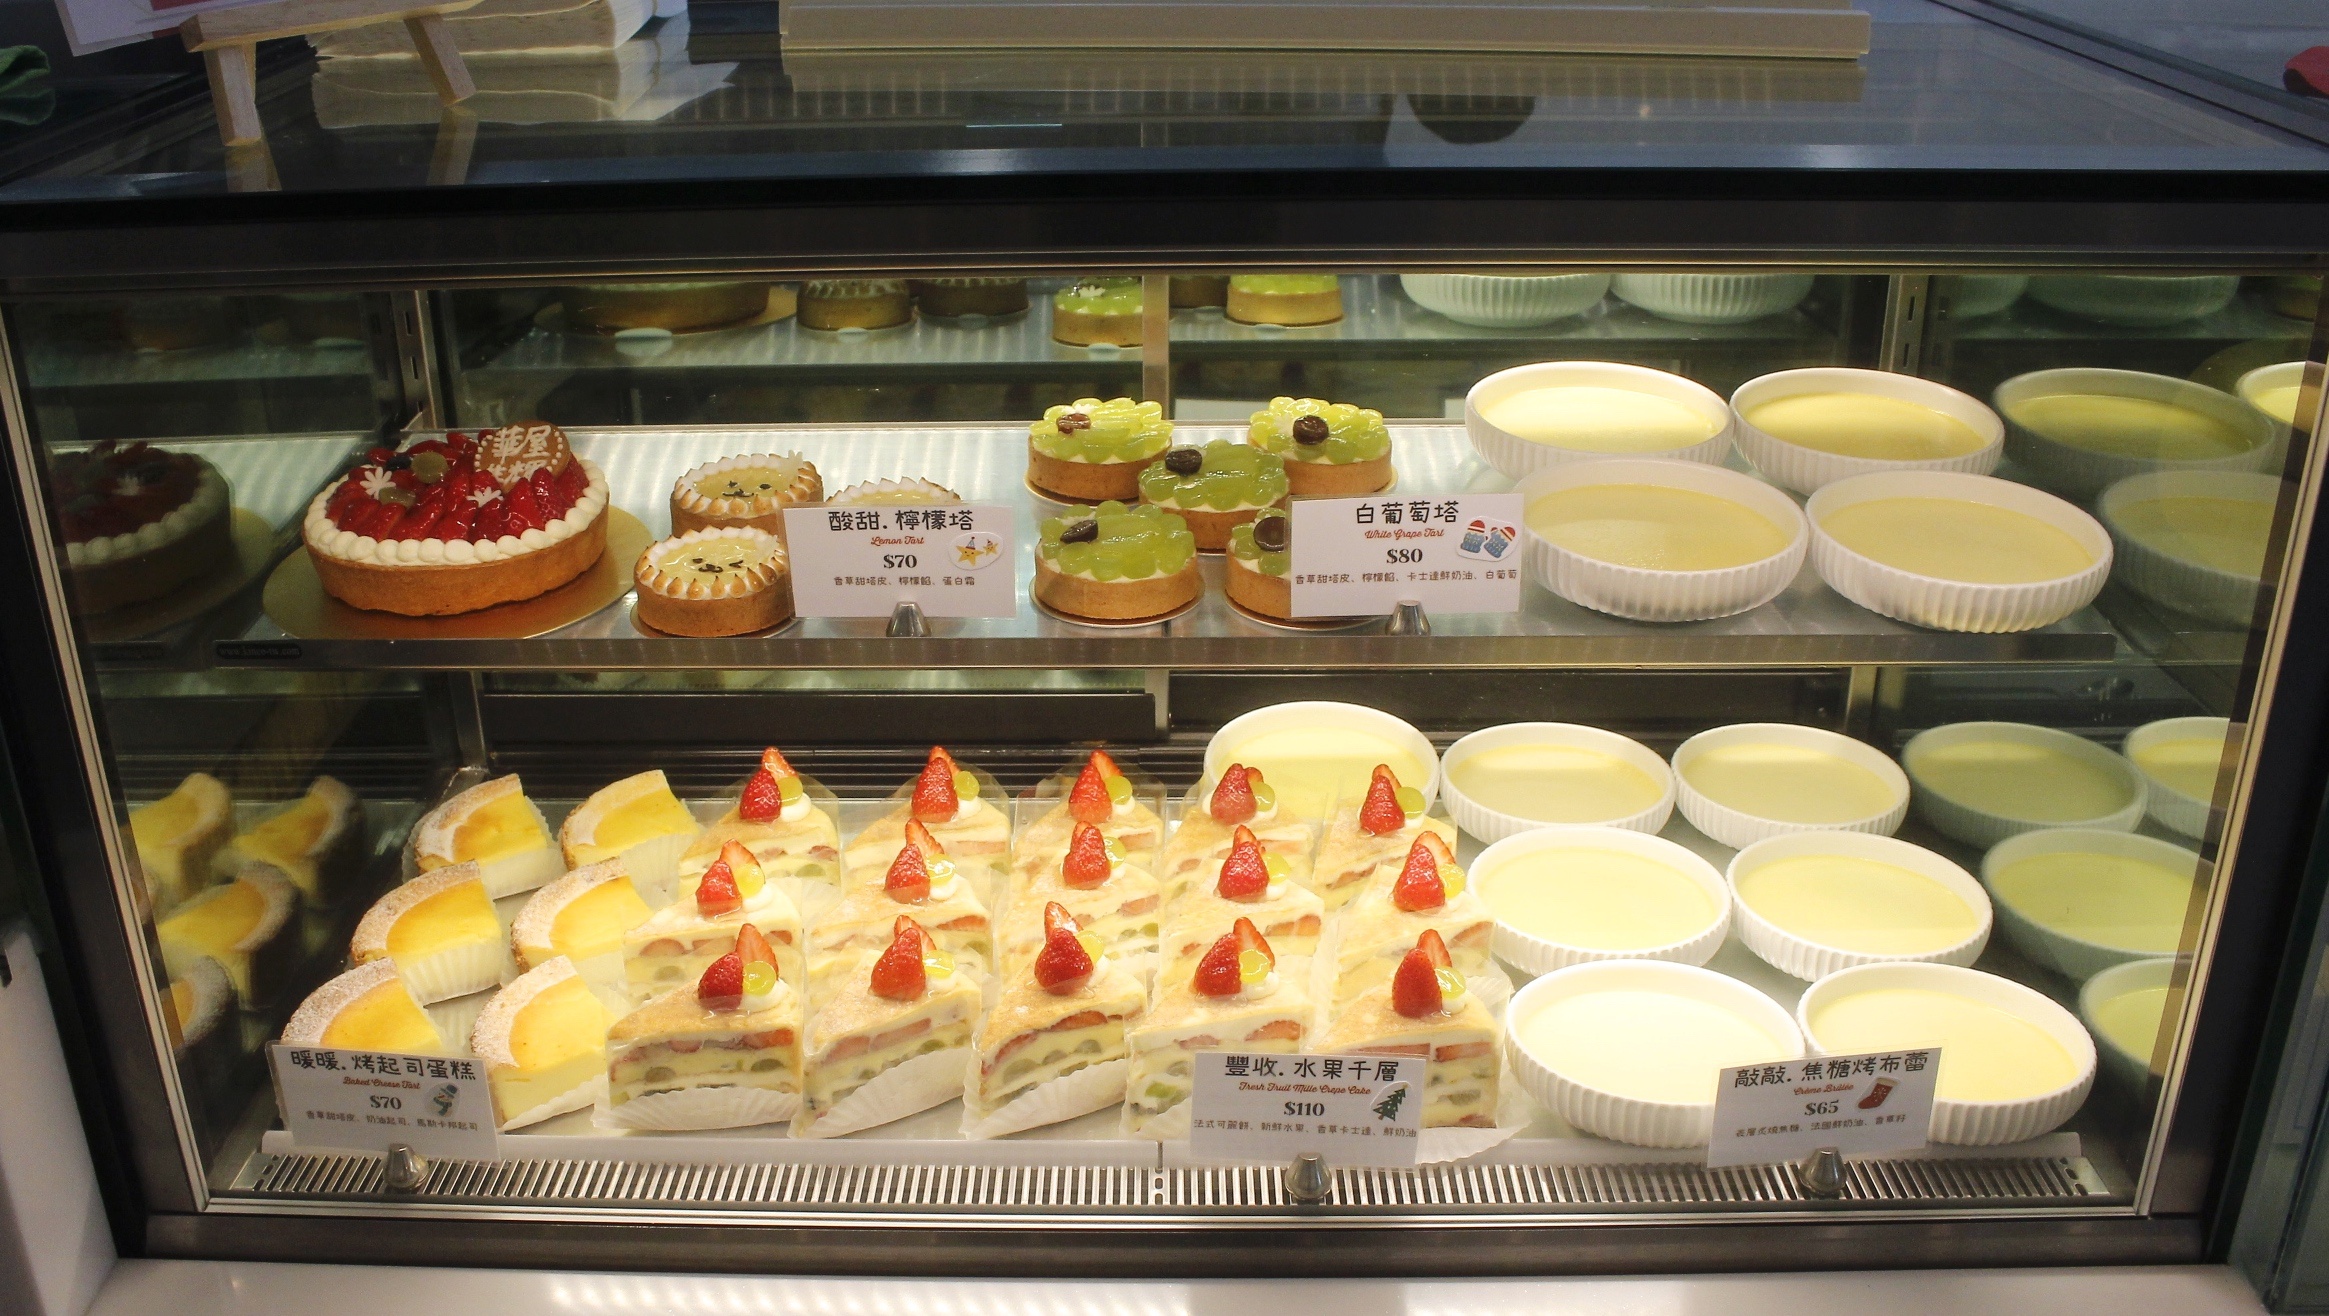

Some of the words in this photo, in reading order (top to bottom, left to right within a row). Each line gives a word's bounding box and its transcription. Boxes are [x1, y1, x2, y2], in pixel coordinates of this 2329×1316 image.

[828, 509, 974, 532] 酸甜.檸檬塔
[1356, 500, 1460, 525] 白葡萄塔
[870, 536, 903, 546] Lemon
[904, 535, 925, 545] Tart
[1364, 529, 1392, 540] White
[1394, 528, 1422, 541] Grape
[1423, 527, 1445, 538] Tart
[883, 554, 917, 569] $70
[1386, 548, 1424, 564] $80
[291, 1050, 477, 1081] 暖暖.烤起司蛋糕
[1225, 1055, 1400, 1082] 豐收.水果千層
[343, 1077, 370, 1088] Baked
[371, 1078, 400, 1090] Cheese
[401, 1081, 421, 1091] Tart
[1238, 1081, 1265, 1091] Fresh
[1267, 1082, 1291, 1093] Fruit
[1293, 1083, 1318, 1094] Mille
[1319, 1083, 1346, 1095] Crepe
[1348, 1085, 1372, 1095] Cake
[369, 1095, 402, 1110] $70
[1283, 1101, 1325, 1117] $110
[1804, 1099, 1840, 1117] $65
